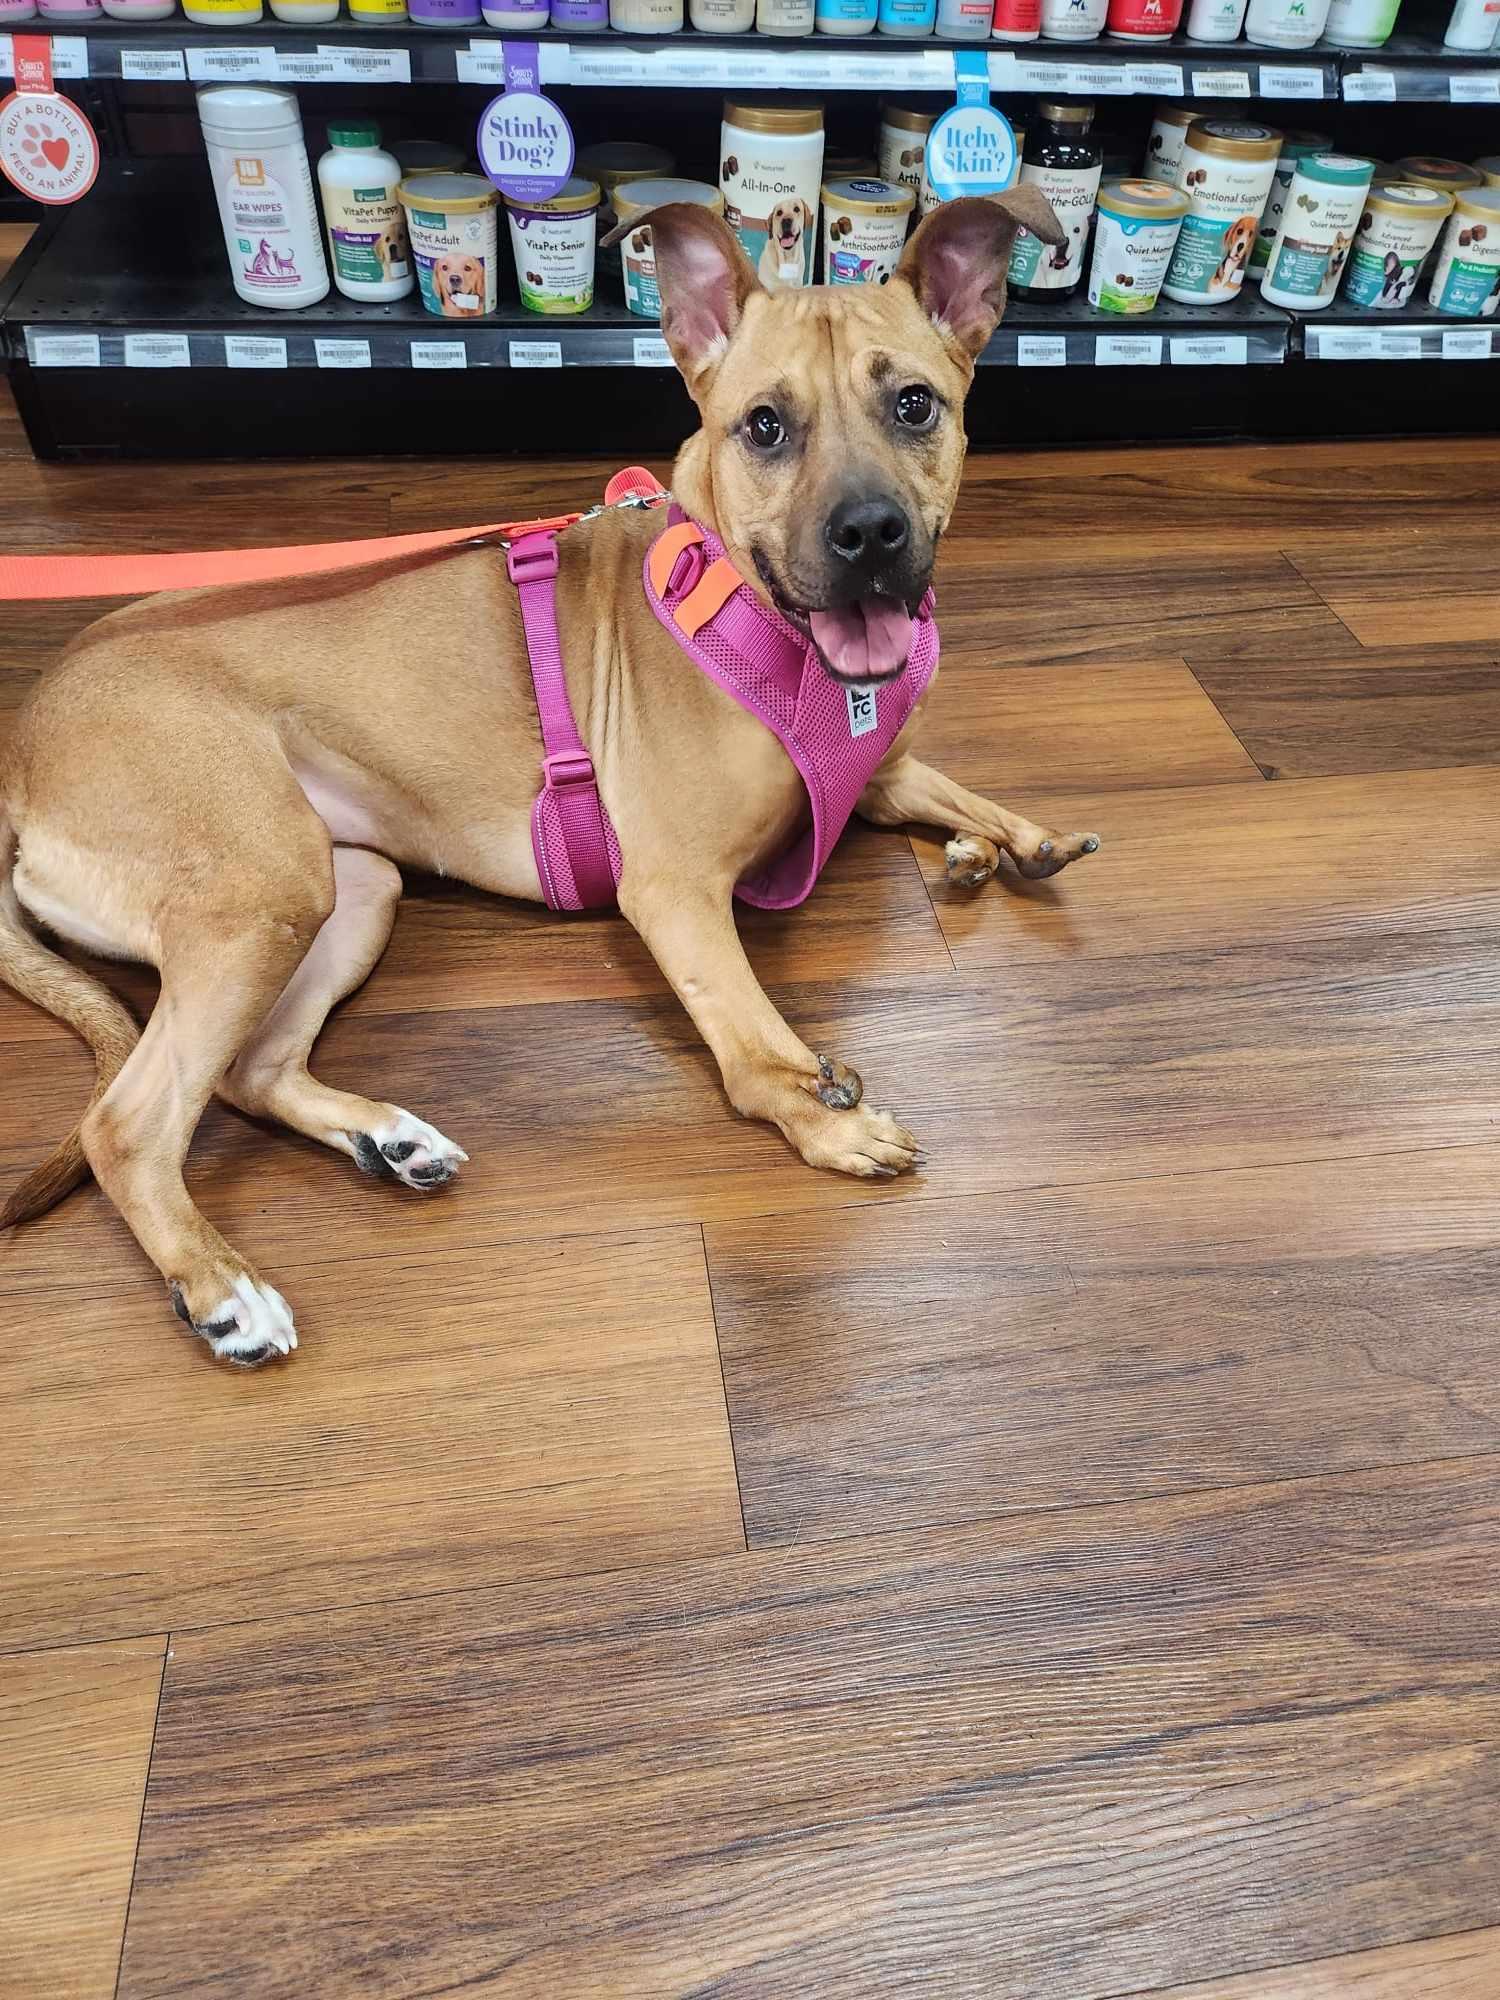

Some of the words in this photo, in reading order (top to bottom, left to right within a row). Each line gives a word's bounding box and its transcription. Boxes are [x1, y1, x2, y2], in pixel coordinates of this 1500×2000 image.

[7, 112, 22, 136] BUY
[25, 106, 32, 115] A
[36, 104, 80, 137] BOTTLE
[489, 115, 560, 145] Stinky
[947, 125, 998, 149] Itchy
[498, 140, 555, 170] Dog?
[943, 150, 1005, 173] Skin?
[10, 152, 34, 181] FEED
[38, 179, 55, 190] AN
[58, 152, 85, 188] ANIMAL
[740, 179, 796, 194] All-In-One
[1193, 187, 1239, 203] Emotional
[232, 202, 250, 212] EAR
[252, 203, 283, 213] WIPES
[342, 206, 374, 216] VitaPet
[435, 235, 460, 246] Adult
[525, 239, 558, 252] VitaPet
[560, 240, 585, 252] Senior
[1125, 243, 1149, 256] Quiet
[853, 701, 871, 719] rc
